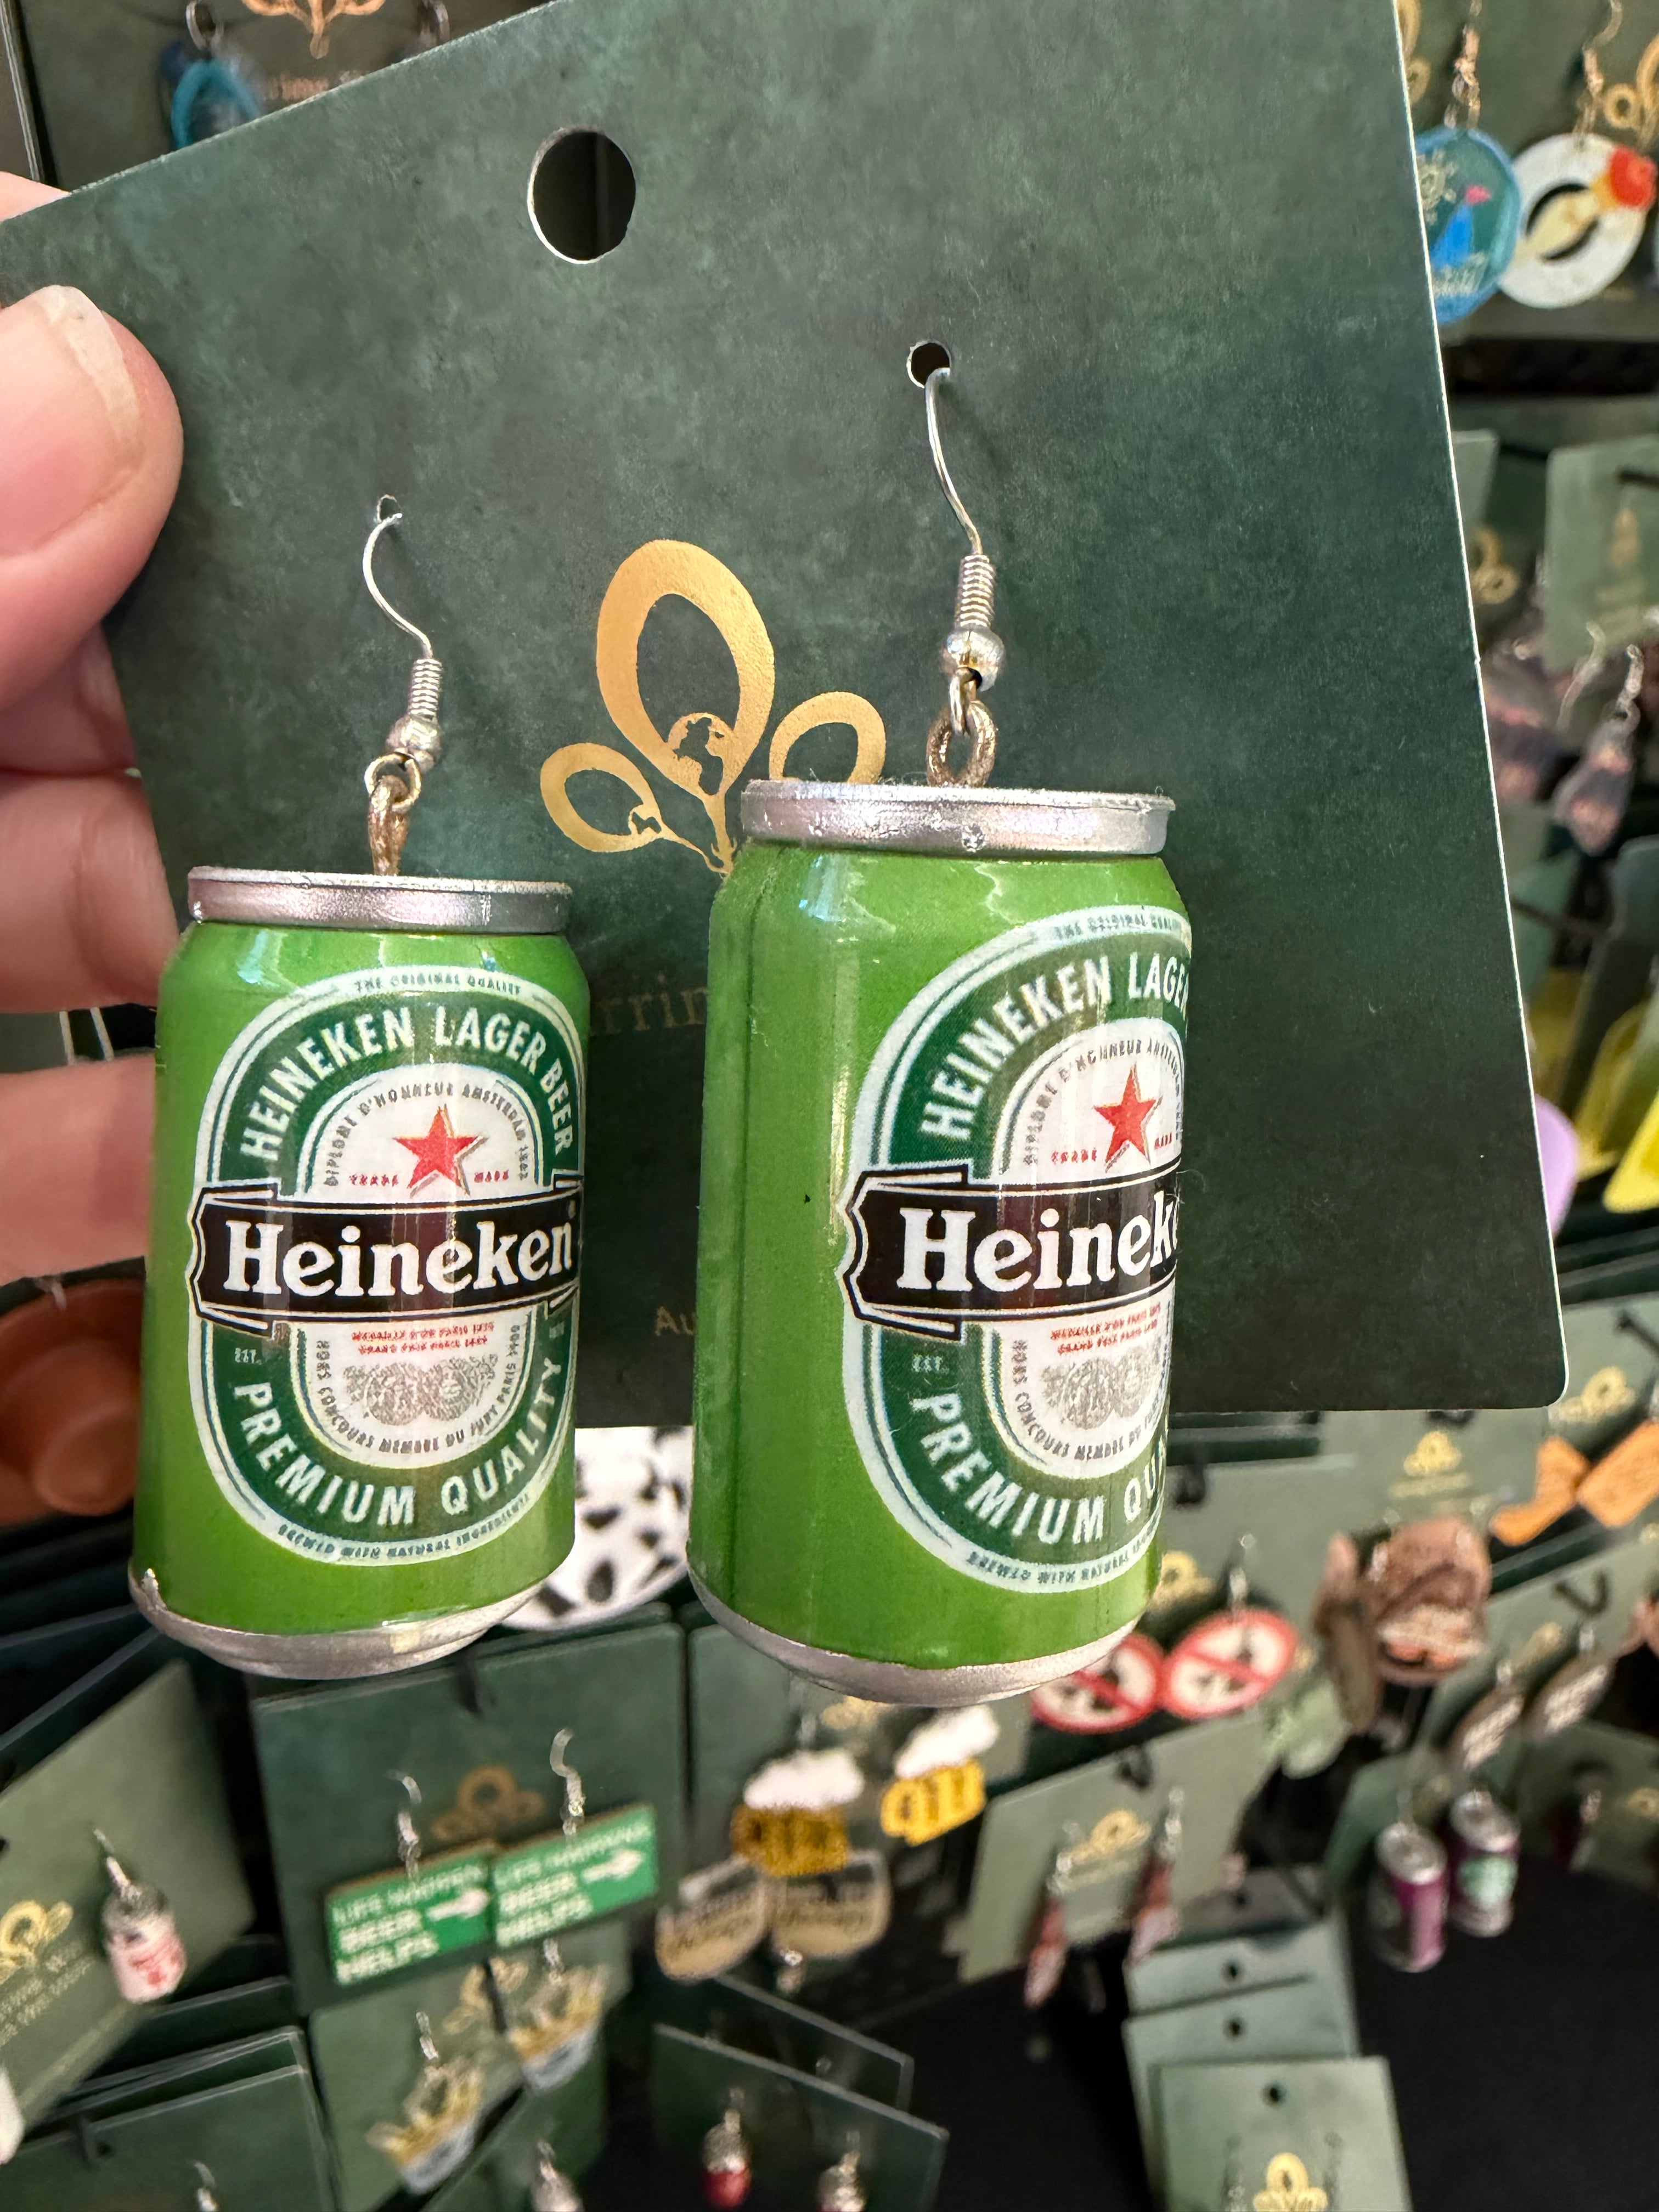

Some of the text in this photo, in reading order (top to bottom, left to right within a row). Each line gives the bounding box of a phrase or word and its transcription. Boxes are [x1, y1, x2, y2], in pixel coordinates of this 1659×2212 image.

[240, 1006, 574, 1161] HEINEKEN LAGER BEER
[919, 956, 1112, 1141] HEINEKEN
[223, 1221, 574, 1297] Heineken
[896, 1189, 1178, 1293] Heinek
[654, 1305, 697, 1336] Au
[231, 1357, 563, 1526] PREMIUM QUALITY
[909, 1392, 1106, 1545] PREMIUM
